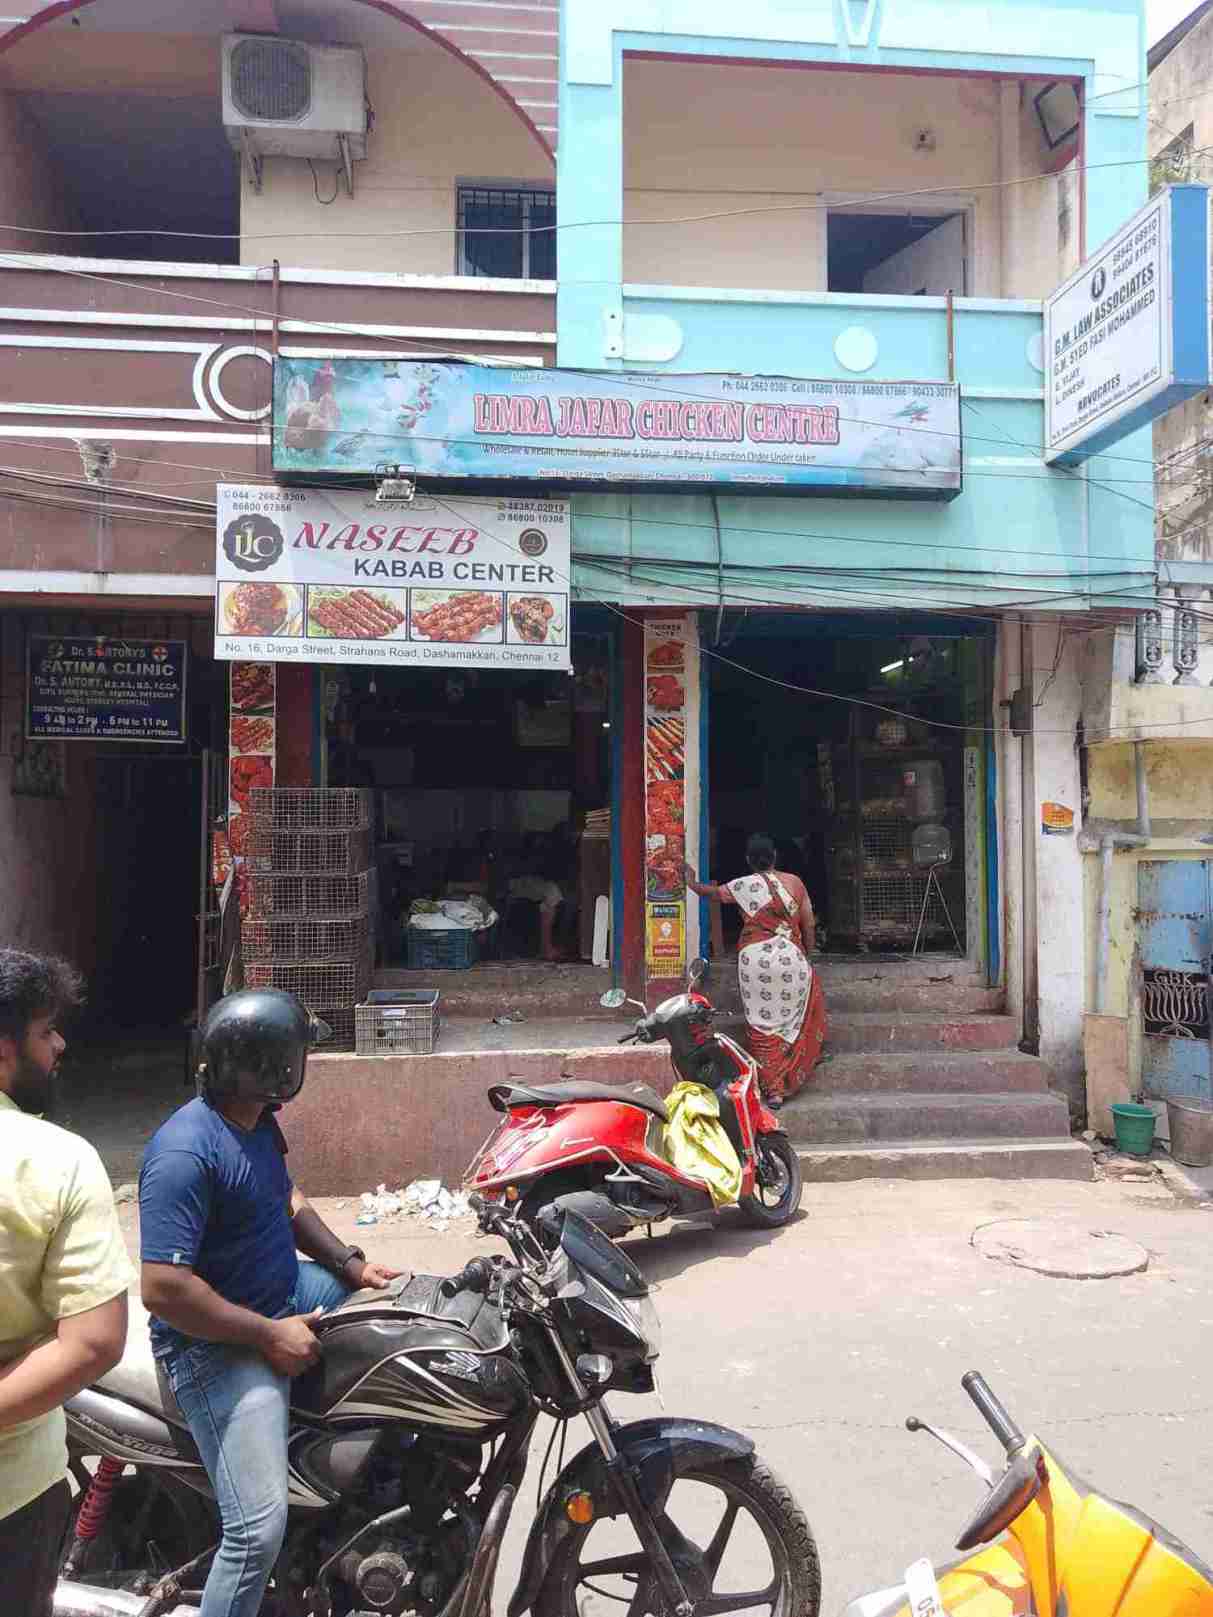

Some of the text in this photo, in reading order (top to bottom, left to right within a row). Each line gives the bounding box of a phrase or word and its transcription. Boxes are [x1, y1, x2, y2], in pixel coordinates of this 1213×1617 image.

[1074, 311, 1092, 340] LAW
[1094, 262, 1154, 324] ASSOCIATES
[1070, 341, 1088, 364] SYED
[1107, 288, 1156, 335] MOHAMMED
[1078, 373, 1120, 412] ADVOCATES
[474, 393, 840, 446] LIMRA JAFAR CHICKEN CENTRE
[291, 520, 480, 555] NASEEB
[353, 558, 555, 584] KABAB CENTER
[41, 660, 176, 677] FATIMA CLINIC
[267, 643, 298, 657] Darga
[338, 644, 386, 657] Strahans
[502, 649, 544, 662] Chennai
[547, 651, 560, 663] 12
[118, 717, 130, 725] PM
[155, 718, 168, 727] PM
